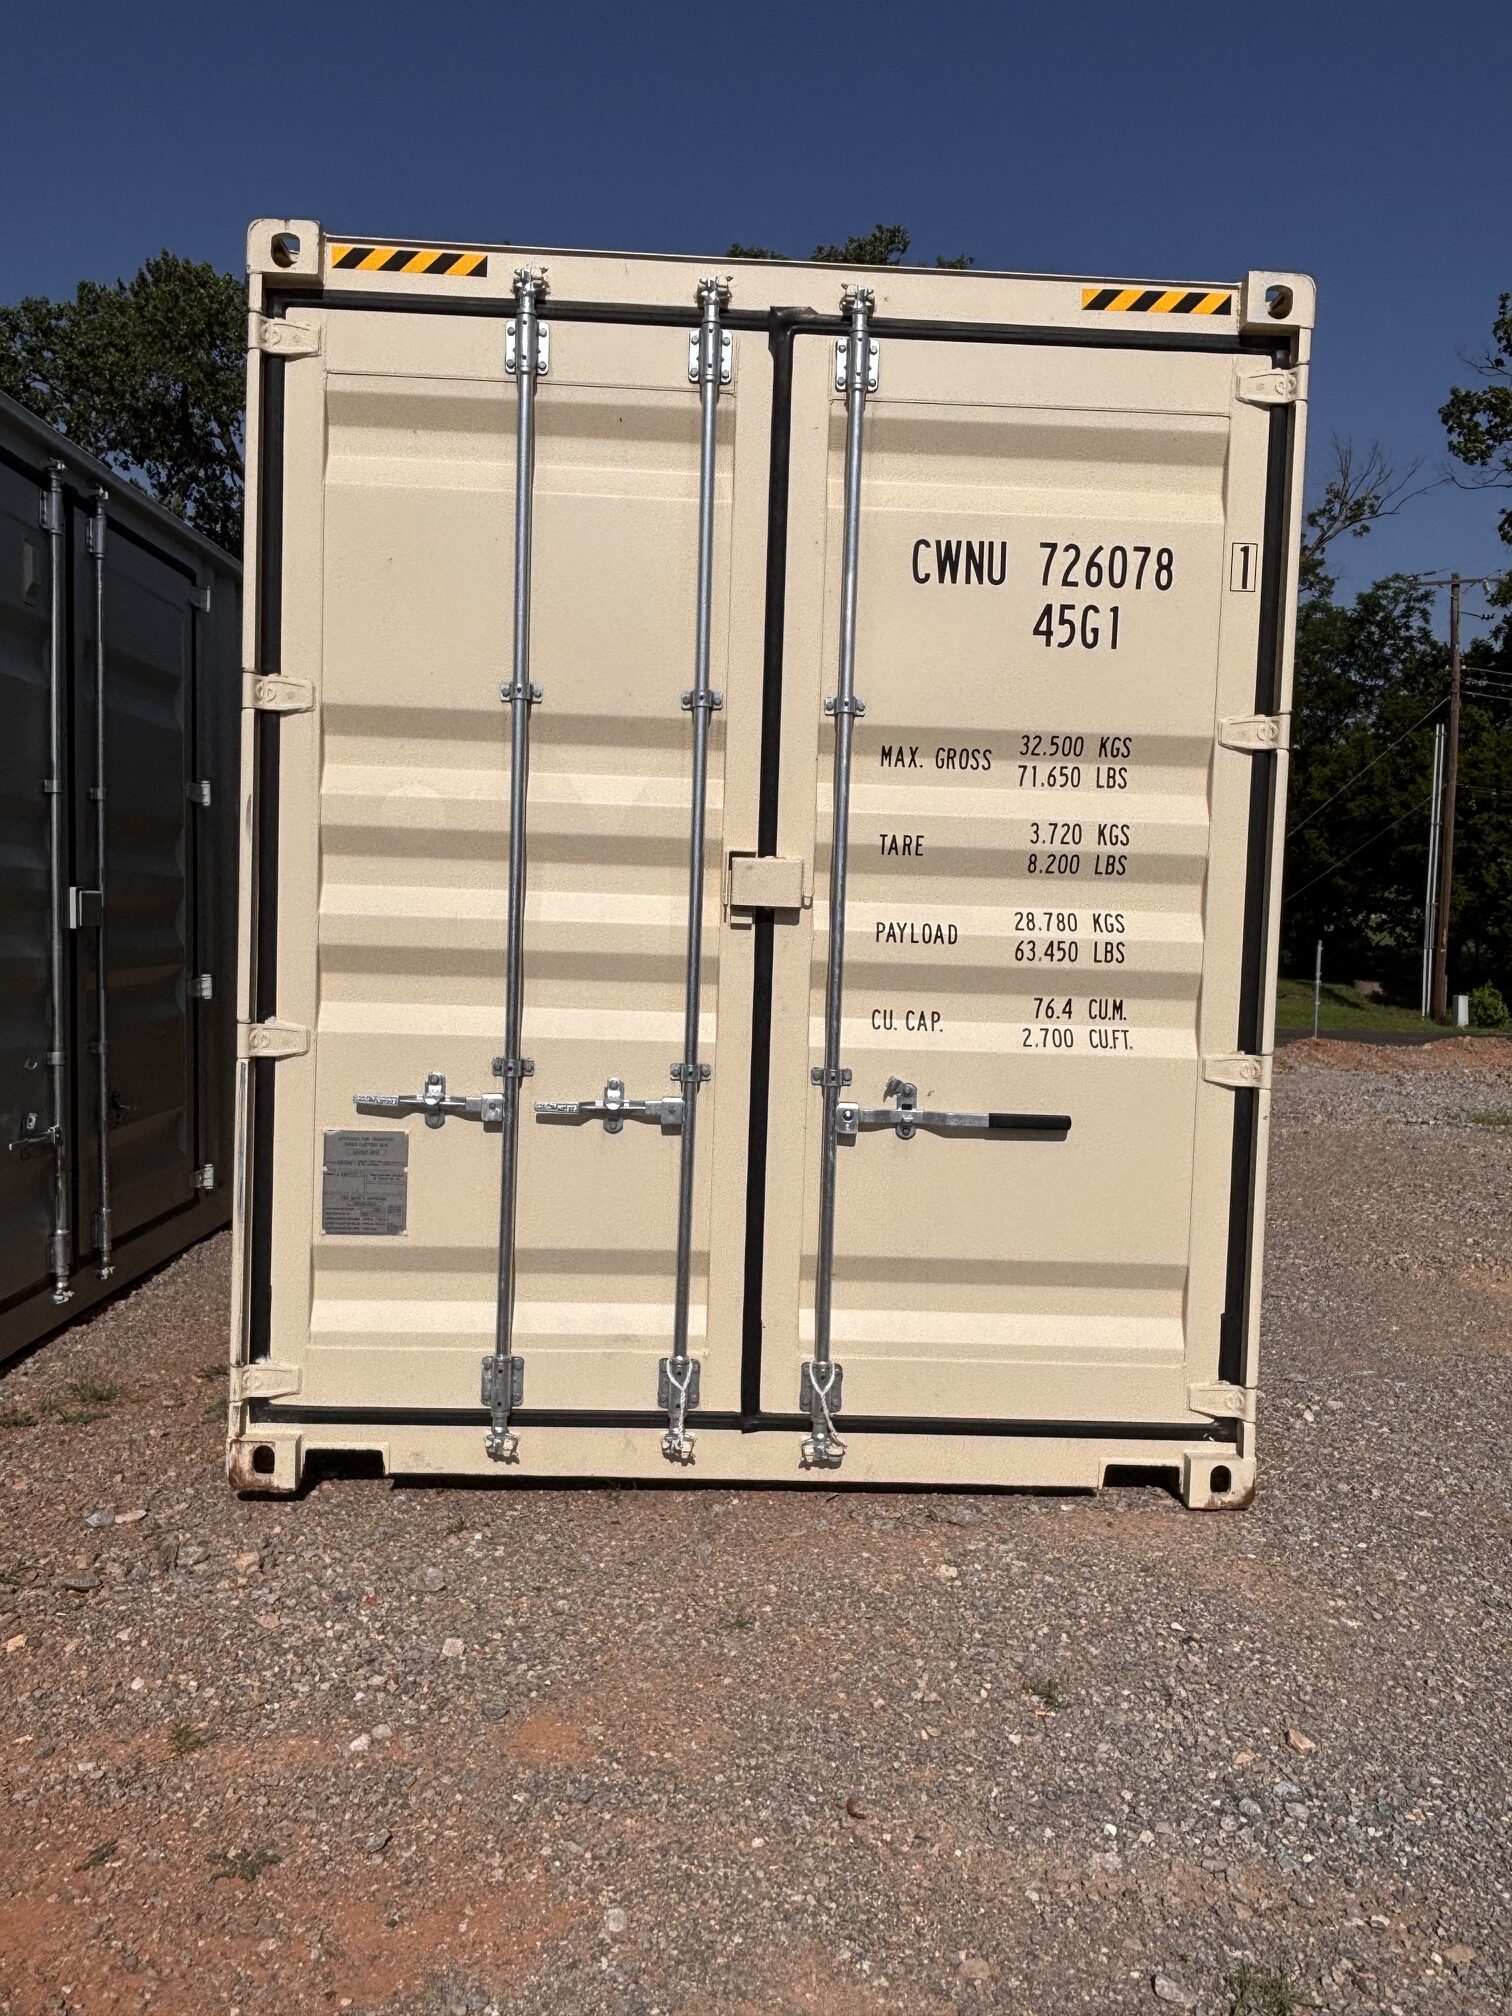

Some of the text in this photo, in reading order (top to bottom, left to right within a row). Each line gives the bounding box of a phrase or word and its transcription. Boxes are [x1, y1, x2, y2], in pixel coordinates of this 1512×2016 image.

[911, 538, 1251, 592] CWNU 726078 1
[1032, 602, 1120, 650] 45G1
[880, 744, 993, 772] MAX. GROSS
[1019, 734, 1133, 759] 32.500 KGS
[1017, 764, 1128, 790] 71.650 LBS
[878, 833, 925, 857] TARE
[1029, 821, 1131, 847] 3.720 KGS
[1027, 852, 1128, 878] 8.200 LBS
[875, 921, 959, 946] PAYLOAD
[1013, 911, 1126, 934] 28.780 KGS
[1014, 939, 1126, 965] 63.450 LBS
[871, 1008, 944, 1033] CU. CAP.
[1033, 996, 1127, 1024] 76.4 CU.M.
[1021, 1027, 1134, 1051] 2.700 CU.FT.
